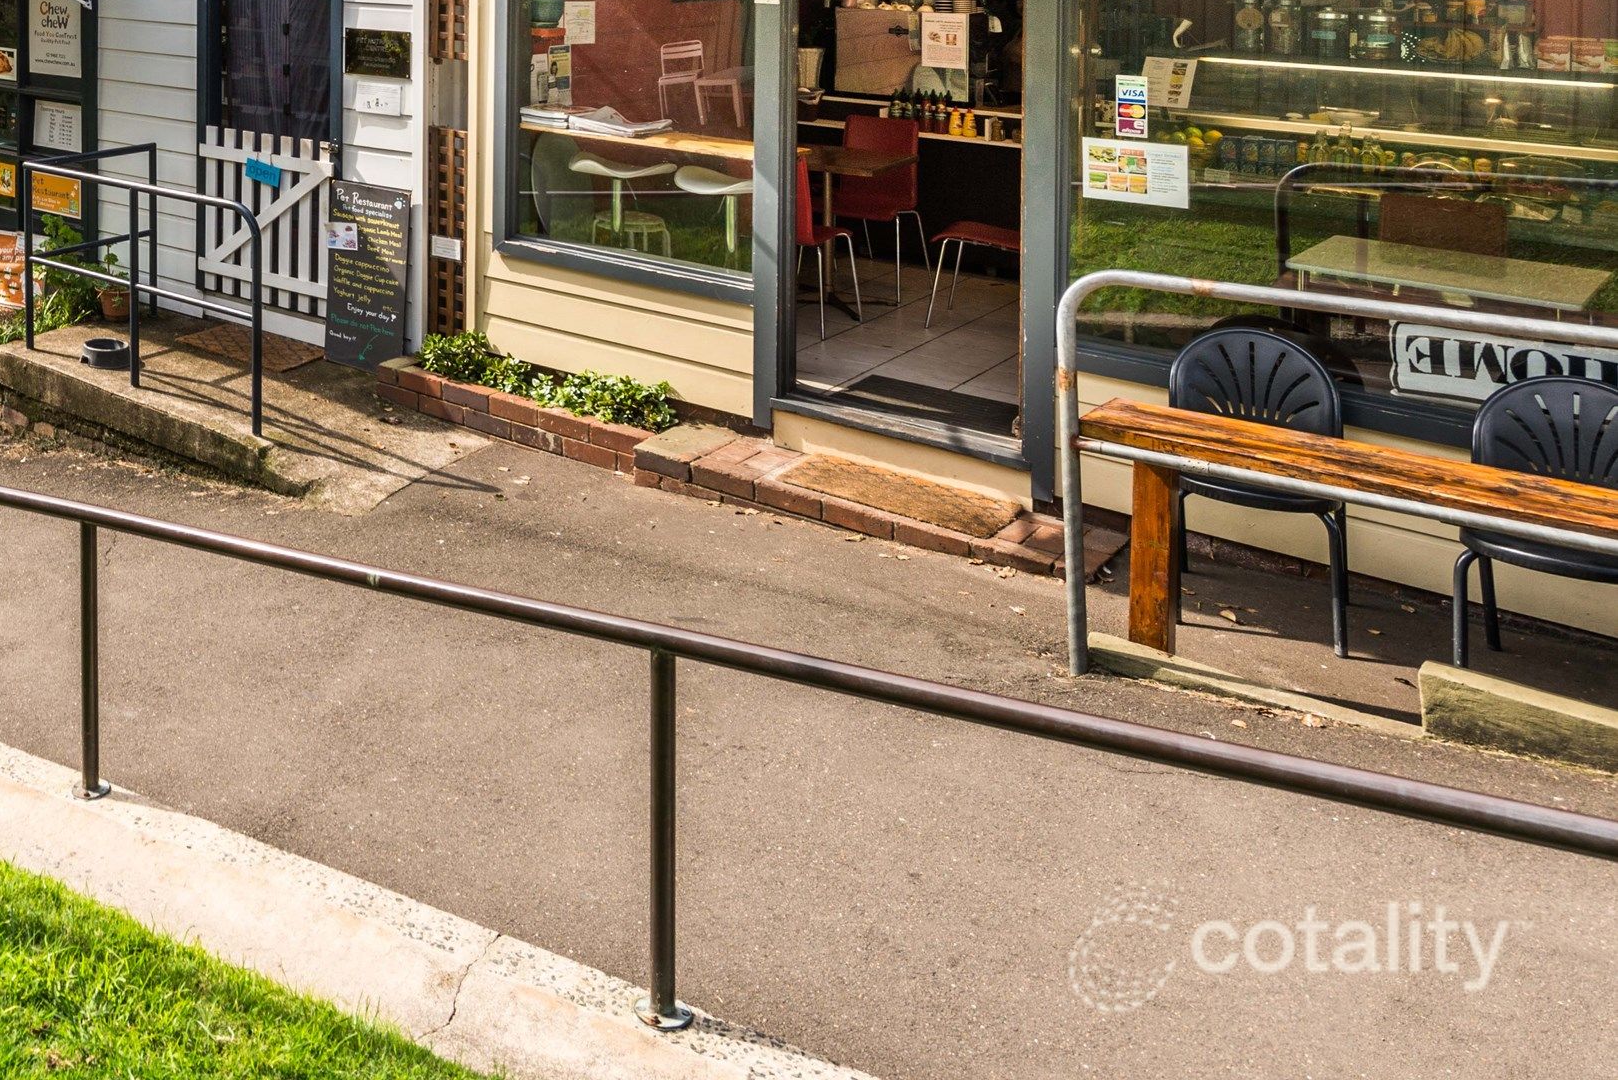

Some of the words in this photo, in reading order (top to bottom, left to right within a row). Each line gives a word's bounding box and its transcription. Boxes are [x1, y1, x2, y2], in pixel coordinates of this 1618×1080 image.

[39, 1, 68, 16] Chew
[1122, 89, 1144, 97] VISA
[250, 166, 277, 183] open
[336, 188, 349, 201] Pet
[352, 192, 392, 210] Restaurant
[352, 205, 364, 213] food
[365, 209, 393, 219] specialist
[367, 236, 388, 245] Chicken
[1, 255, 13, 263] any
[334, 264, 355, 275] Organic
[354, 260, 390, 273] cappuccino
[363, 285, 395, 296] cappuccino
[347, 302, 364, 315] Enjoy
[378, 311, 389, 322] day
